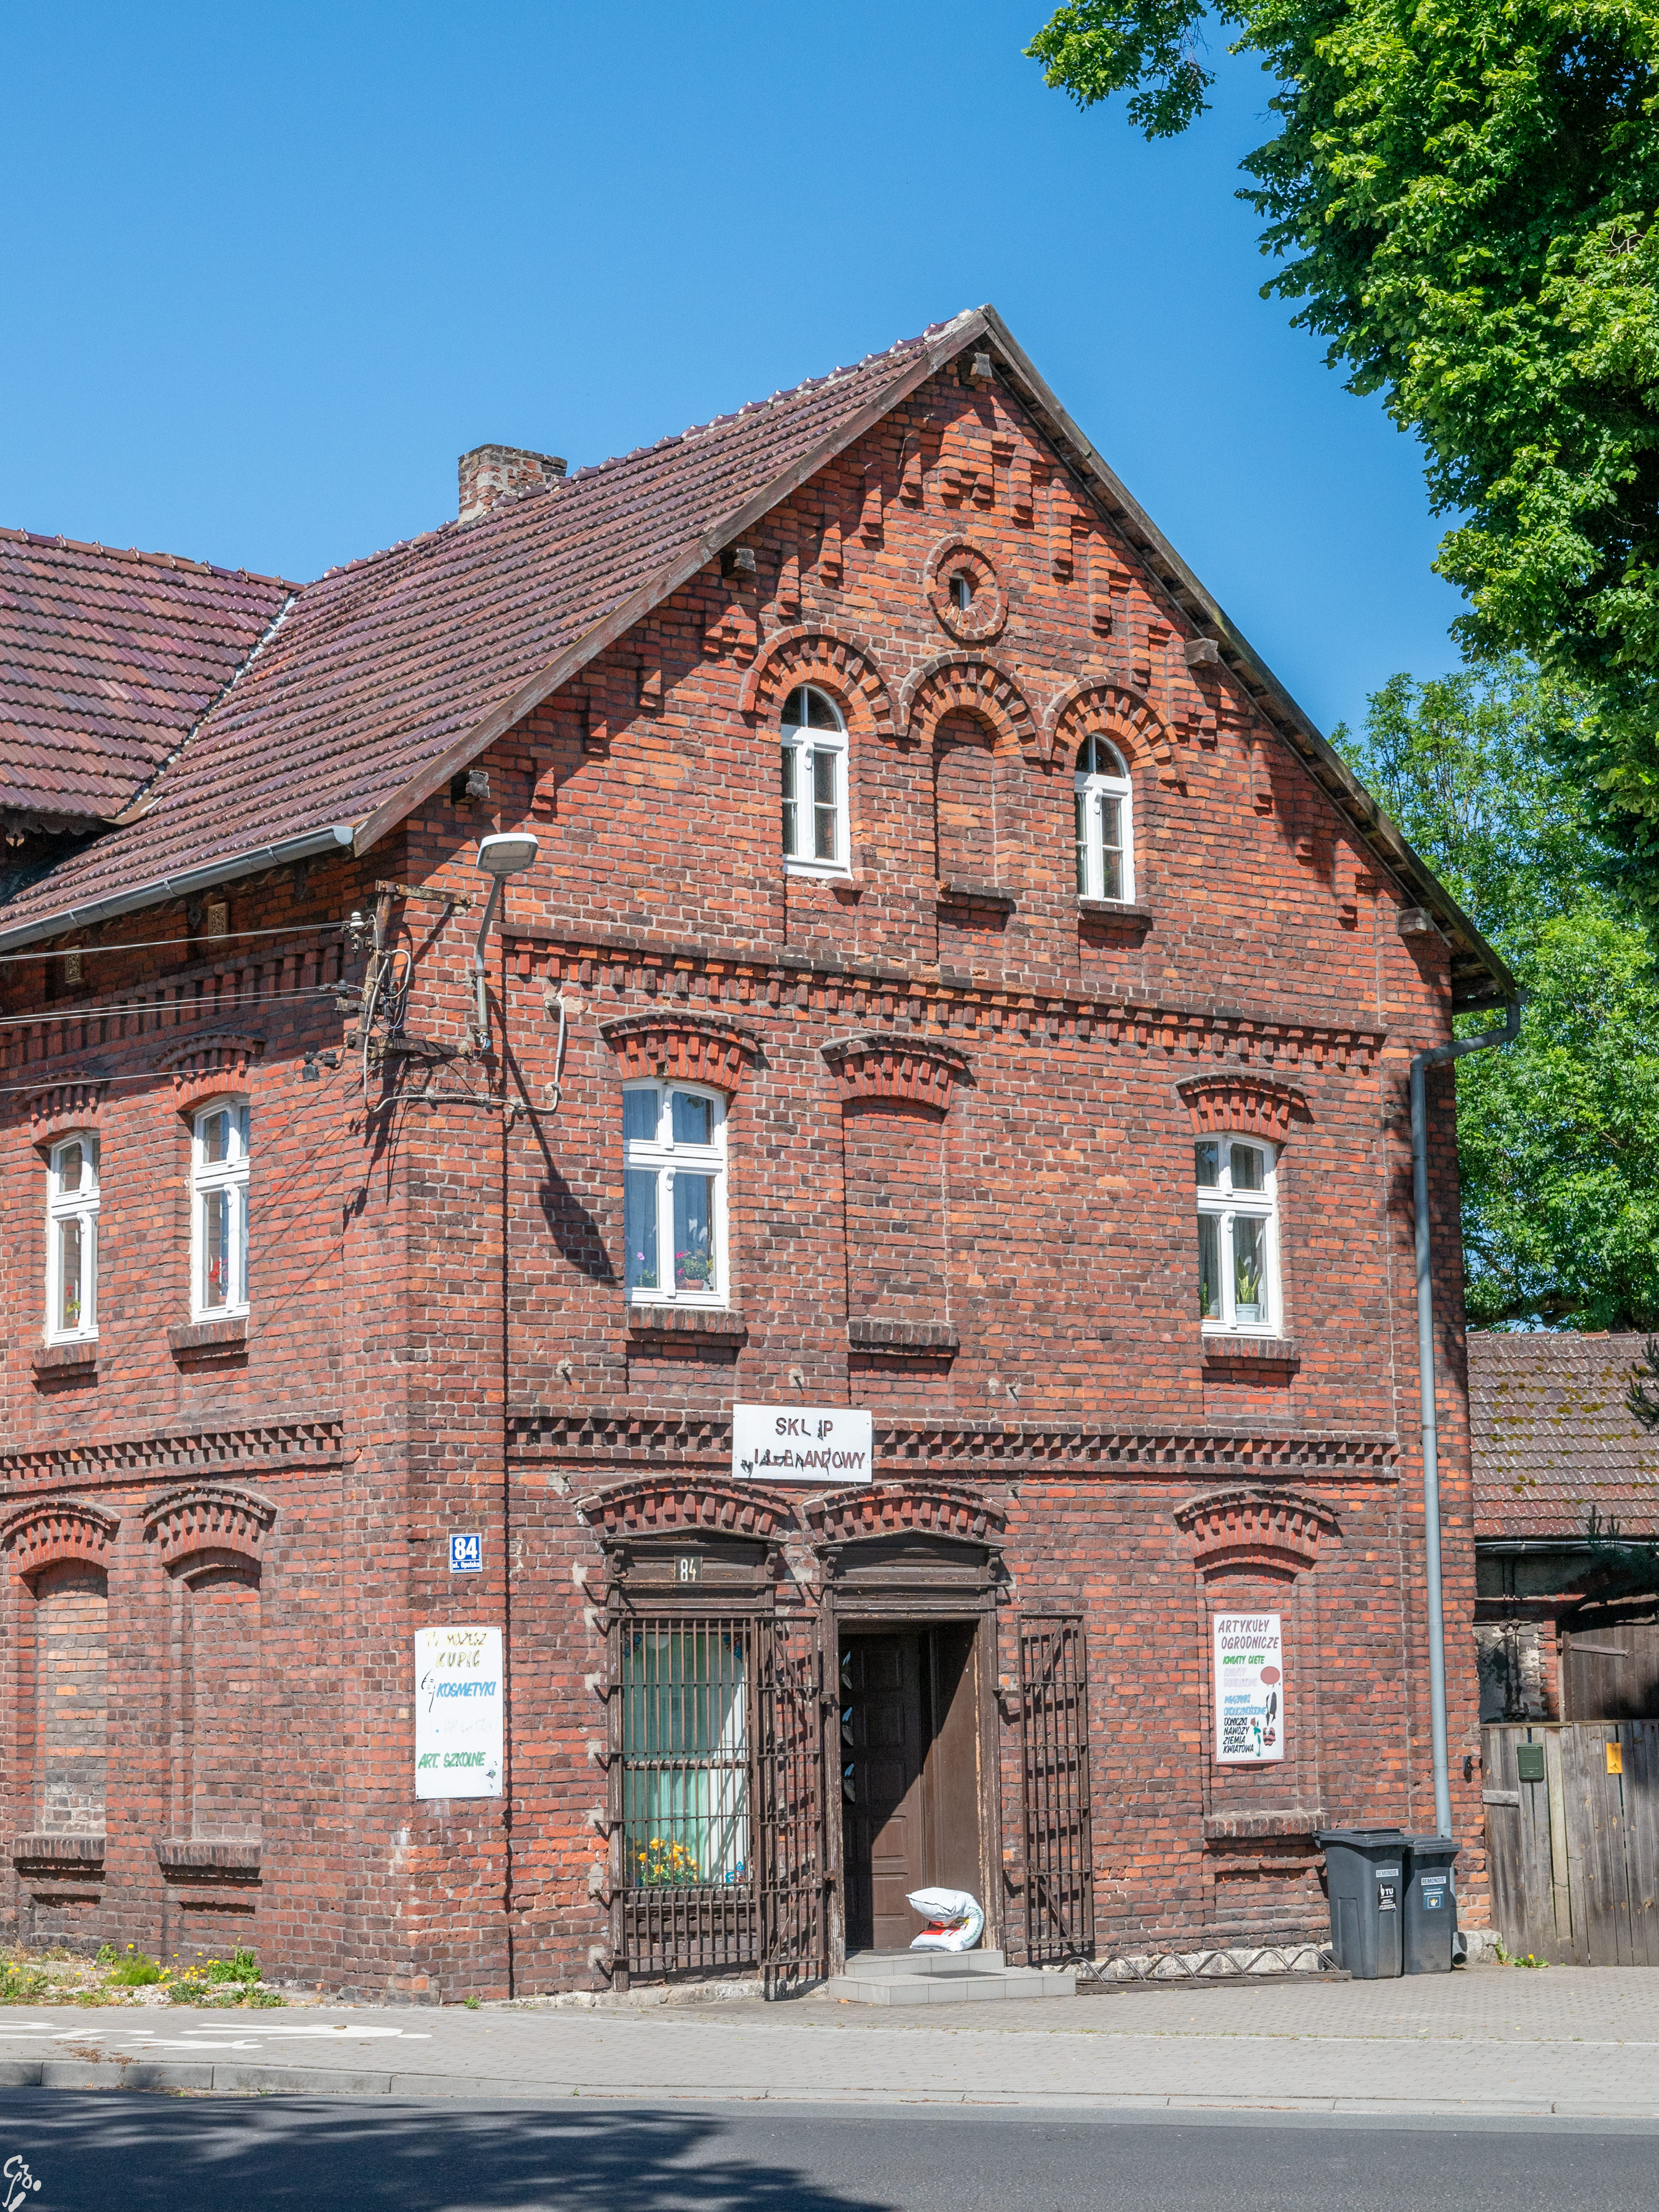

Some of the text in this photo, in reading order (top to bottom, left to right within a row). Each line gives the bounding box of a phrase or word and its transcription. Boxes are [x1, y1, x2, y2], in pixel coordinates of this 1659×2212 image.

[455, 1537, 477, 1560] 84
[680, 1559, 697, 1582] 84
[1218, 1619, 1269, 1633] ARTYKUŁY
[1222, 1636, 1279, 1650] OGRODNICZE
[1223, 1655, 1246, 1665] KWIATY
[436, 1681, 497, 1697] KOSMETYKI
[1224, 1717, 1247, 1726] DONICZKI
[1223, 1726, 1250, 1736] NAWOZY
[1223, 1736, 1245, 1745] ZIEMIA
[1223, 1744, 1254, 1754] KWIATOWA
[418, 1751, 486, 1769] ART. SZKOLNE
